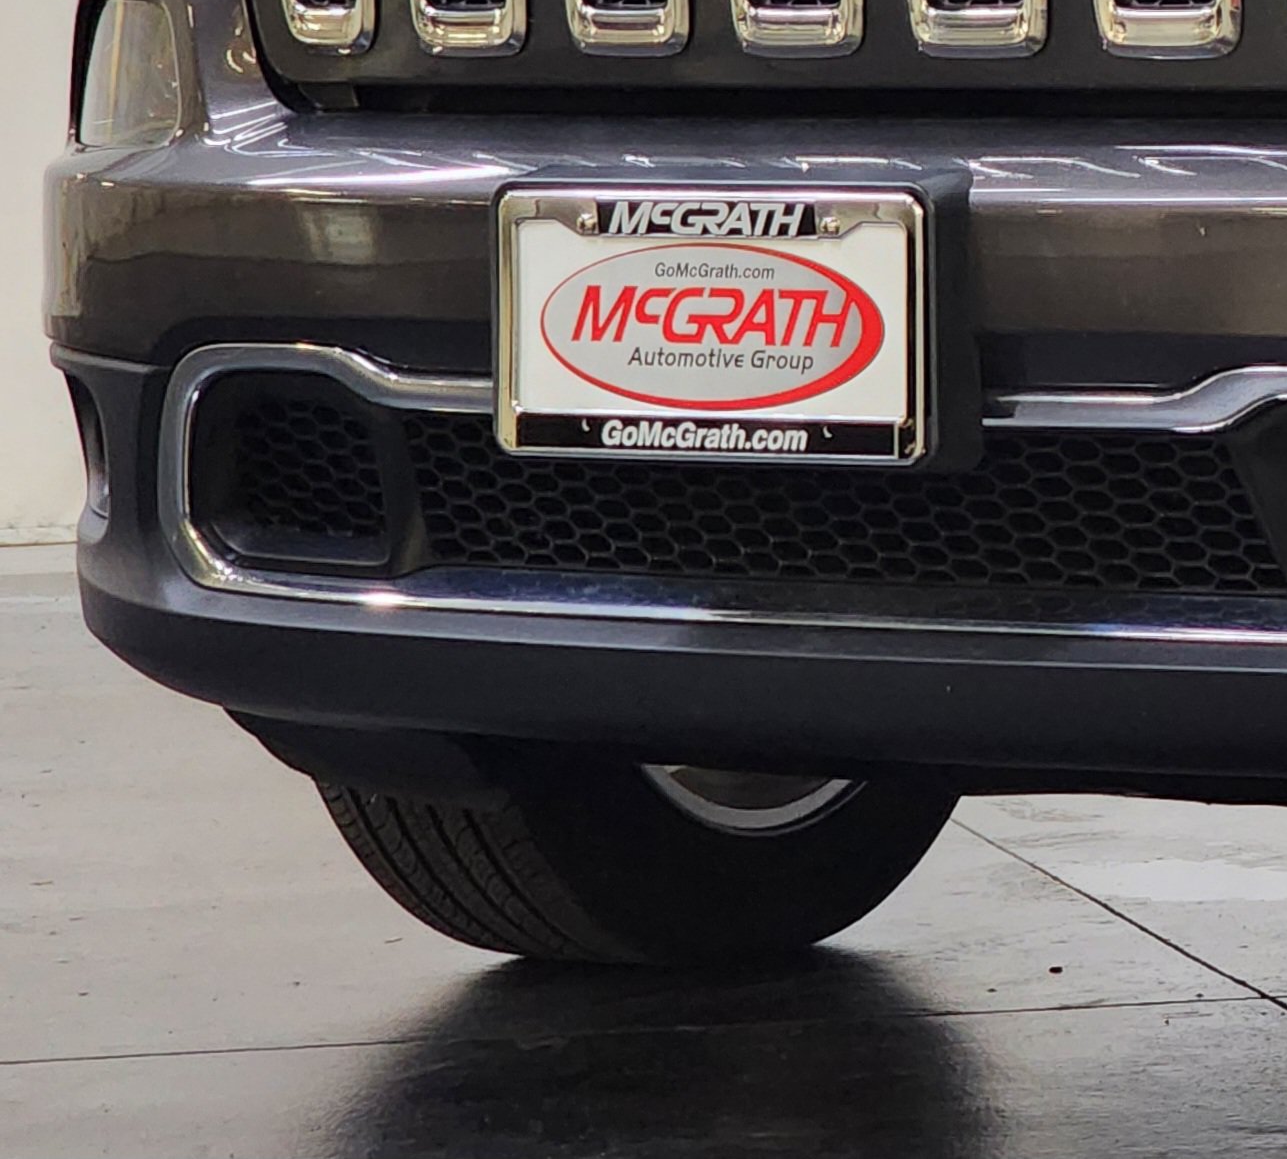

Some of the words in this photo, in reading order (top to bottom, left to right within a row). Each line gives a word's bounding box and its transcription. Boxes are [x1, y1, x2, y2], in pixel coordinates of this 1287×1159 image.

[653, 262, 776, 281] GoMcGrath.com
[627, 346, 745, 369] Automotive
[750, 349, 815, 375] Group
[601, 419, 809, 452] GoMcGrath.com
